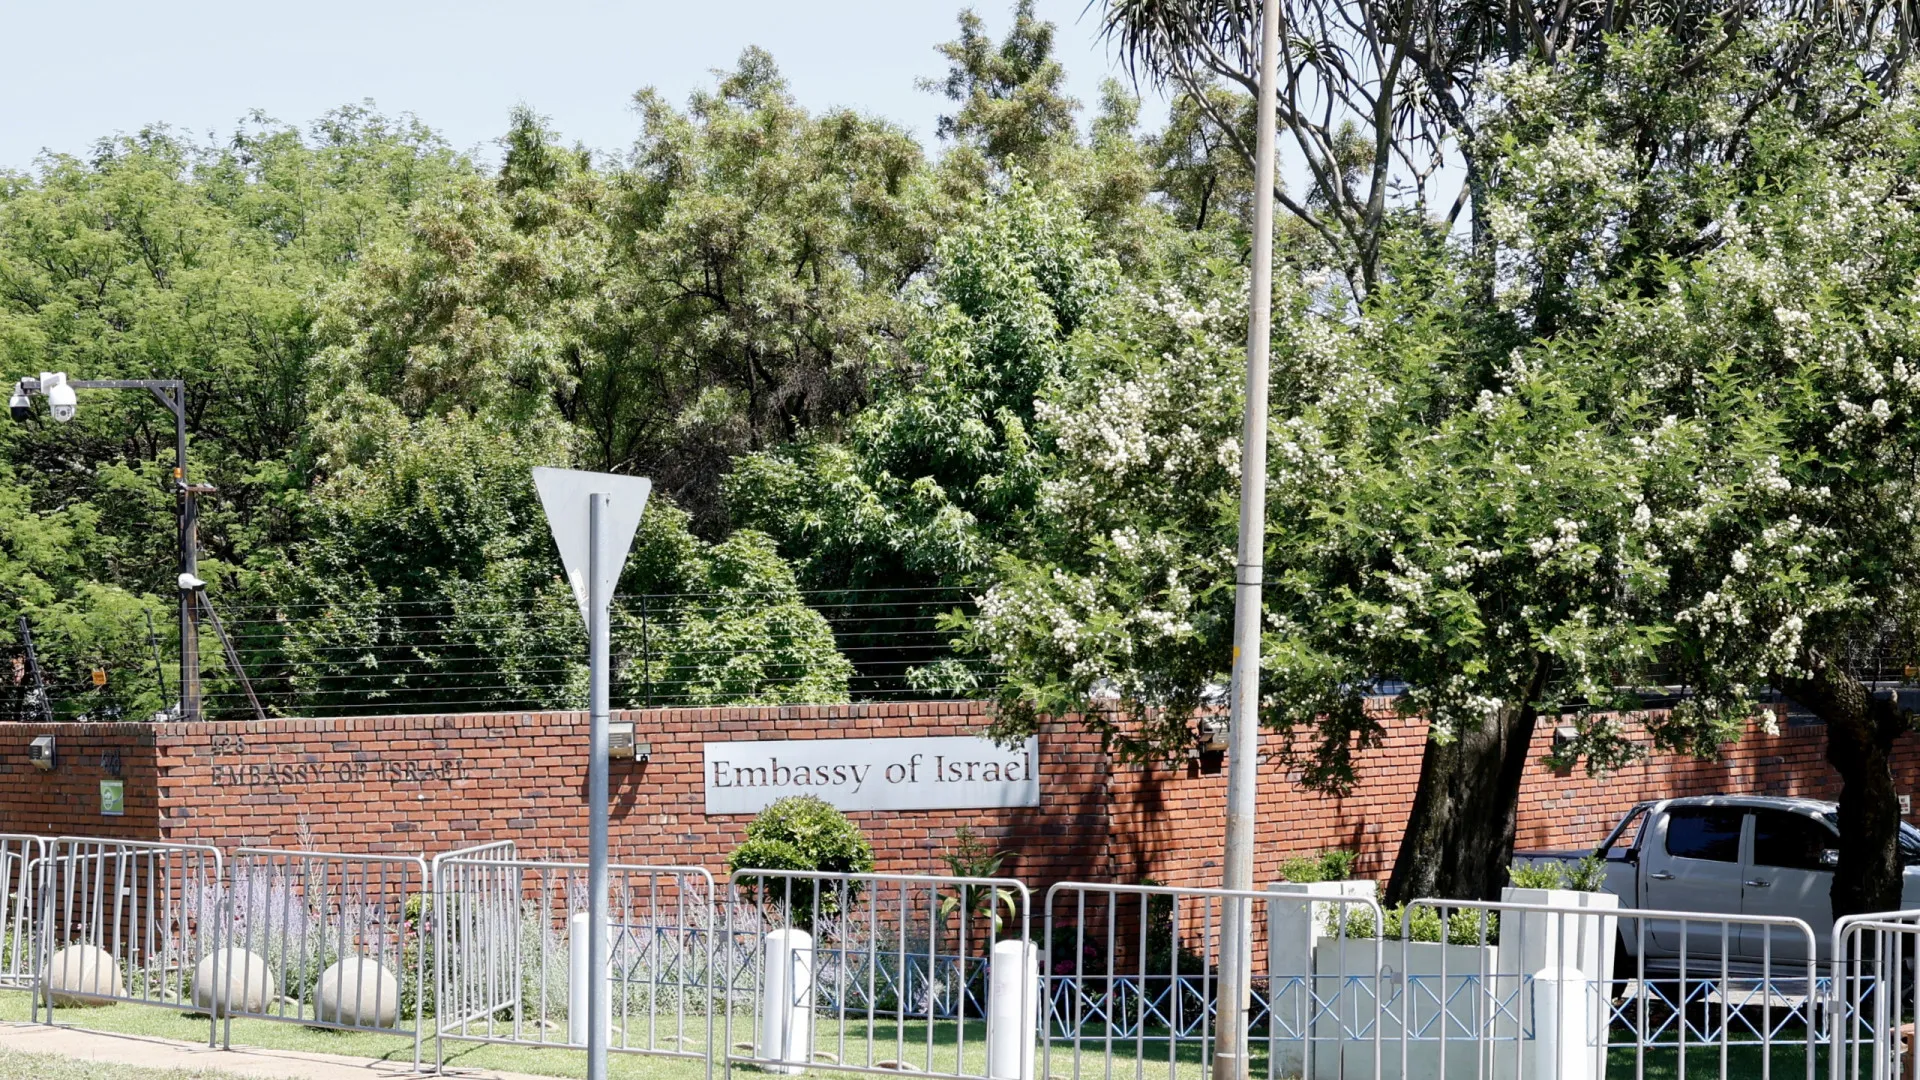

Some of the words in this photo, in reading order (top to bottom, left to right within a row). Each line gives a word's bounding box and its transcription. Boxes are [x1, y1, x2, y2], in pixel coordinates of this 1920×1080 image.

[211, 735, 245, 755] 428
[210, 765, 324, 788] EMBASSY
[338, 762, 368, 783] OF
[381, 758, 470, 782] ISRAEL
[711, 757, 872, 794] Embassy
[885, 753, 923, 784] of
[934, 752, 1033, 783] Israel
